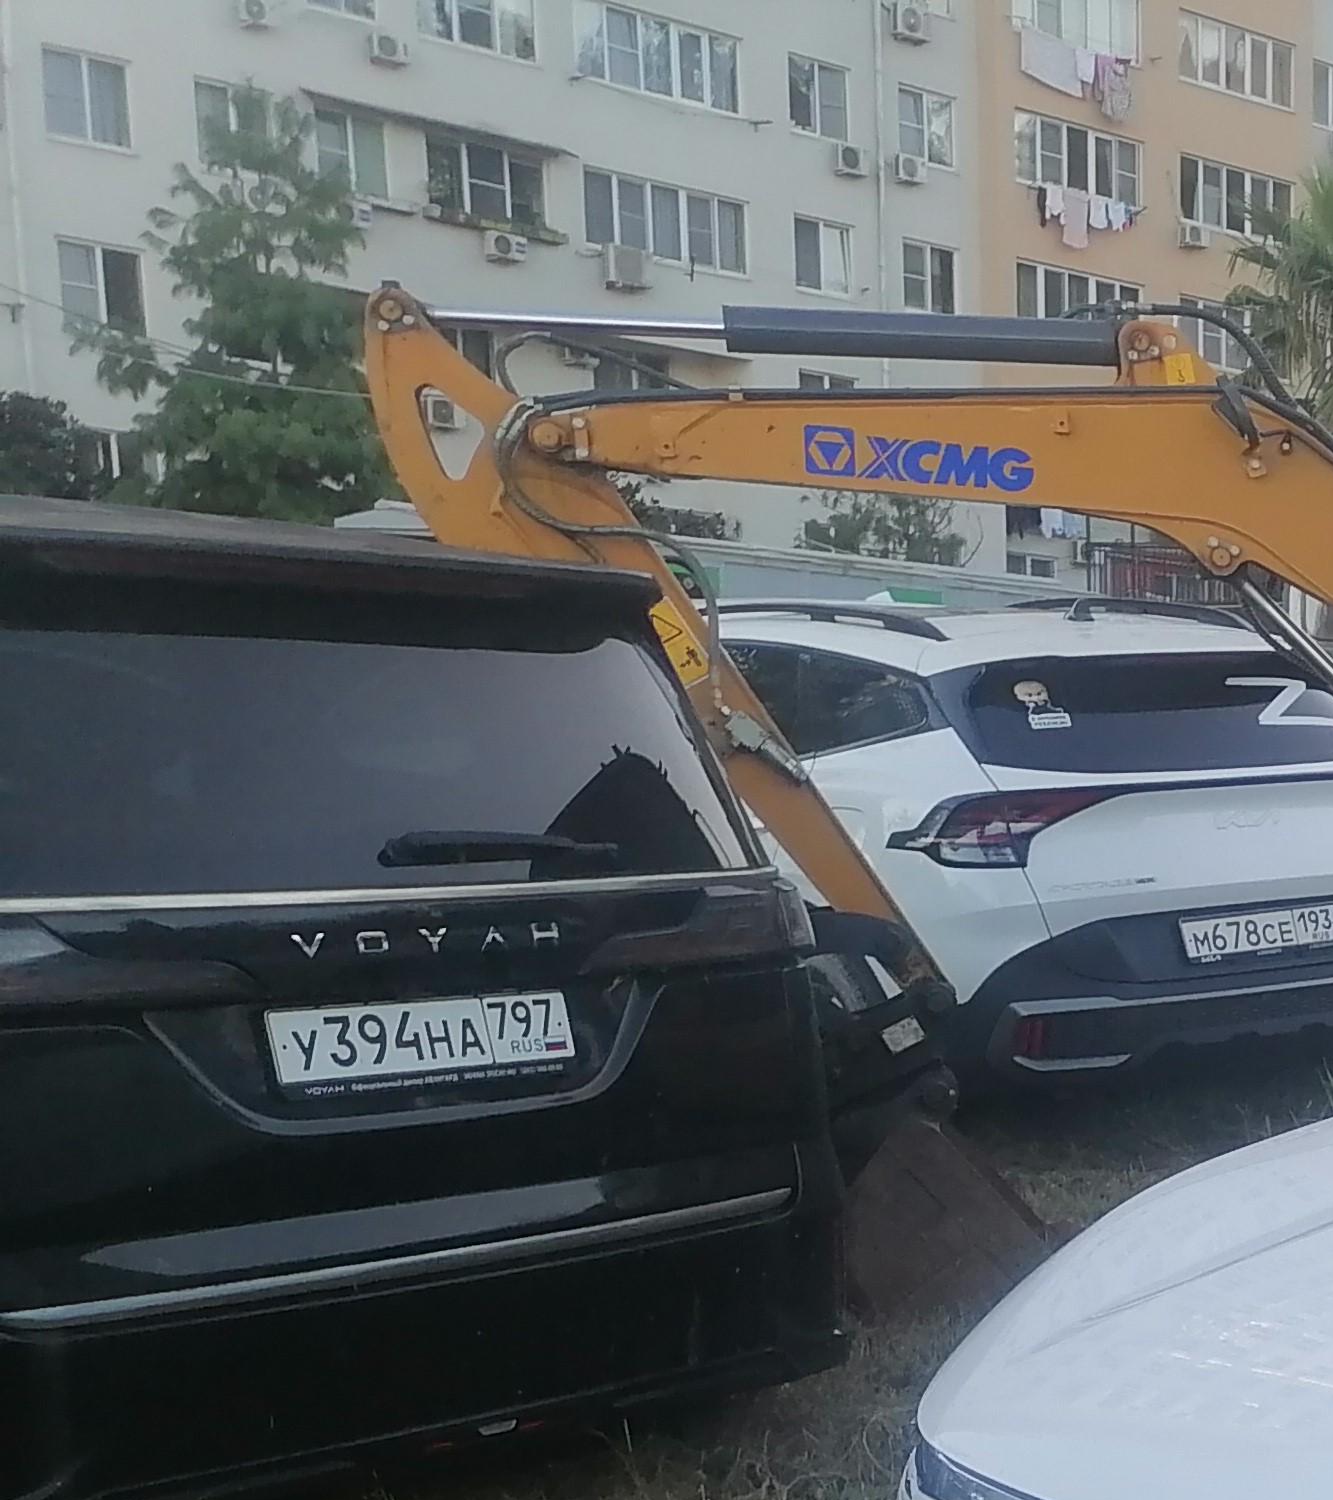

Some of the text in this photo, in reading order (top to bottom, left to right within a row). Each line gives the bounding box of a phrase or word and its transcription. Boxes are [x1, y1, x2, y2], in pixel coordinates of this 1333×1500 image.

[856, 435, 1034, 491] XCMG
[291, 922, 560, 958] VOYAH
[1192, 908, 1332, 954] М678СЕ 193
[291, 999, 551, 1071] У394НА 797
[511, 1040, 544, 1054] RUS
